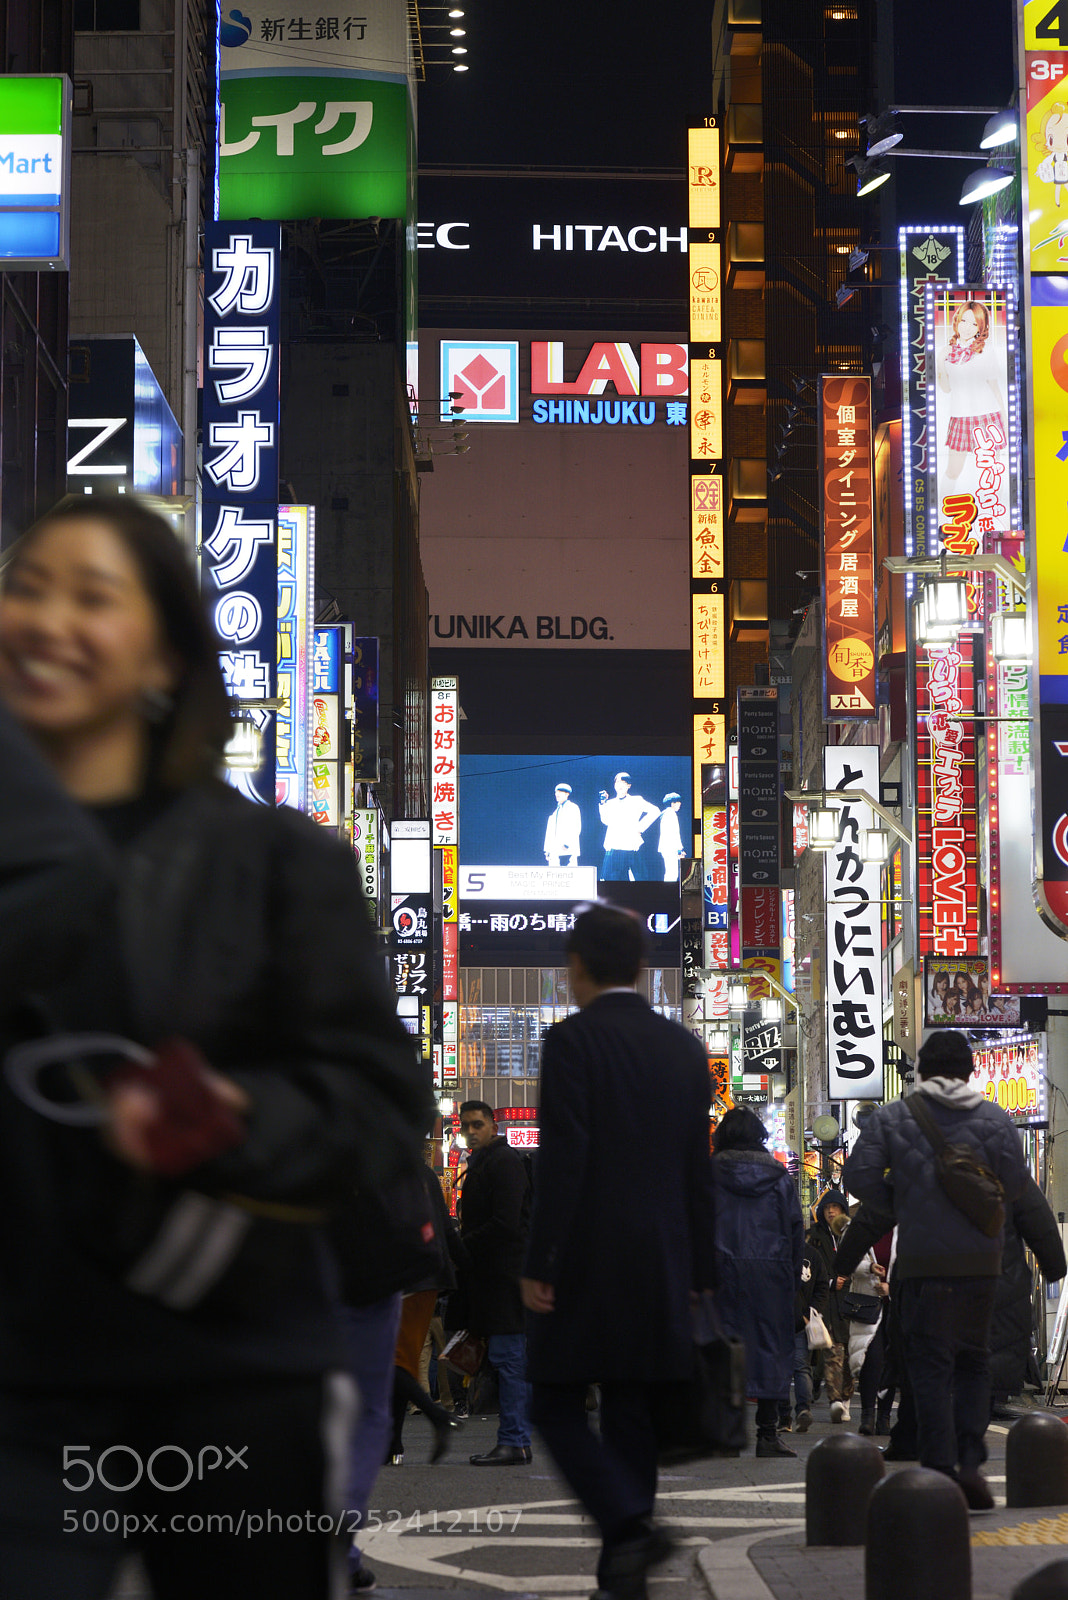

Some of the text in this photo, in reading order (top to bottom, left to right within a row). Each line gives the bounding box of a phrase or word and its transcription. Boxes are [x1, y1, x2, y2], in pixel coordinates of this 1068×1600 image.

[260, 16, 368, 41] 新生銀行
[1031, 60, 1064, 80] 3F
[220, 101, 373, 156] レイク
[703, 117, 716, 128] 10
[532, 224, 688, 252] HITACH
[708, 232, 715, 242] 9
[709, 349, 716, 359] 8
[532, 400, 688, 425] SHINJUKU 東
[709, 464, 717, 474] 7
[206, 234, 276, 806] カラオケの鉄
[836, 404, 859, 617] 個室ダイニング居酒屋
[695, 527, 721, 574] 魚金
[711, 583, 718, 593] 6
[536, 616, 614, 641] BLDG.
[697, 605, 713, 687] ちびすけバル
[713, 703, 720, 714] 5
[834, 695, 861, 709] 入口
[434, 703, 455, 831] お好み焼き
[510, 1130, 540, 1146] 歌舞
